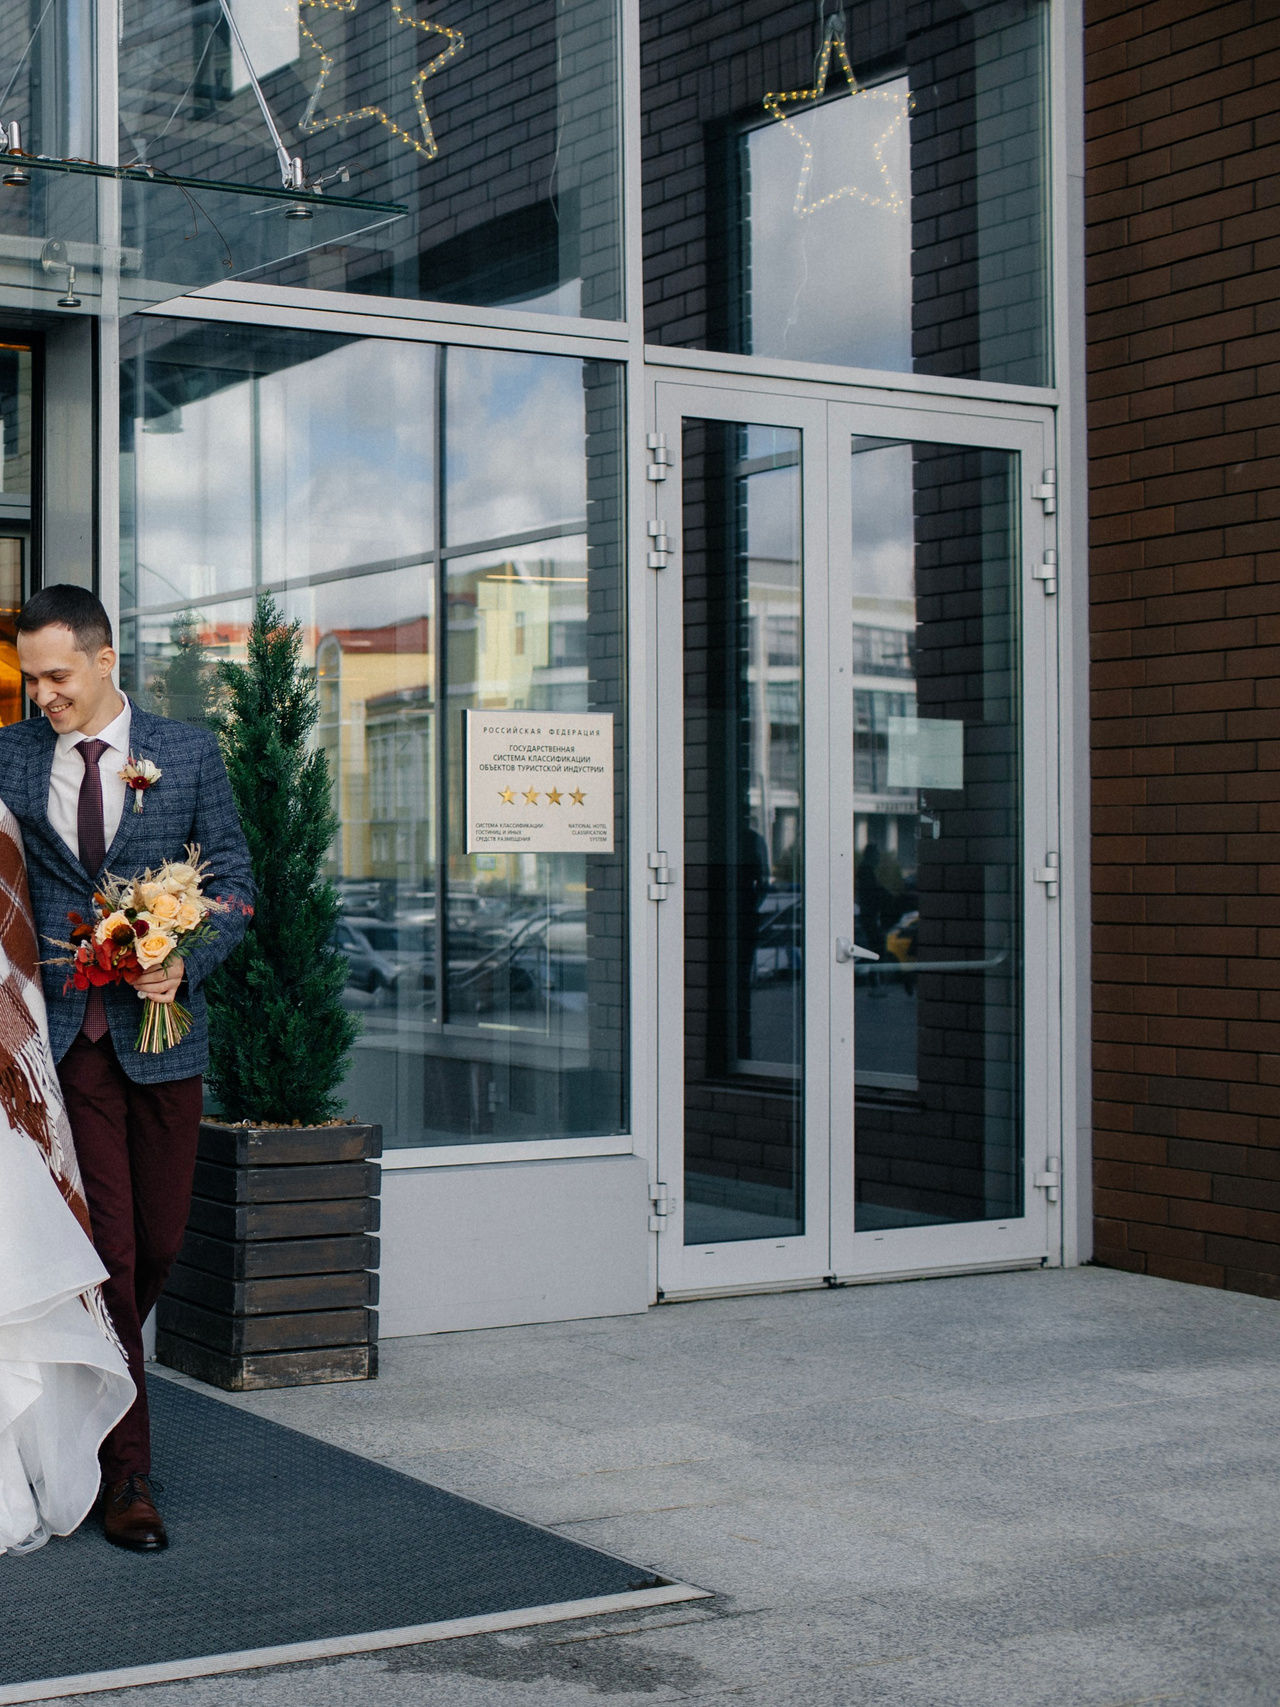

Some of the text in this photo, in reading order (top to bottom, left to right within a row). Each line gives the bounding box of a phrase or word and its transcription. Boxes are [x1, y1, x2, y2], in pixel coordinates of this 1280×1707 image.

[483, 726, 601, 737] РОССИЙСКАЯ ФЕДЕРАЦИЯ
[509, 744, 575, 753] ГОСУДАРСТВЕННАЯ
[492, 754, 591, 764] СИСТЕМА КЛАССИФИКАЦИИ
[478, 763, 605, 774] ОБЪЕКТОВ ТУРИСТСКОЙ ИНДУСТРИИ
